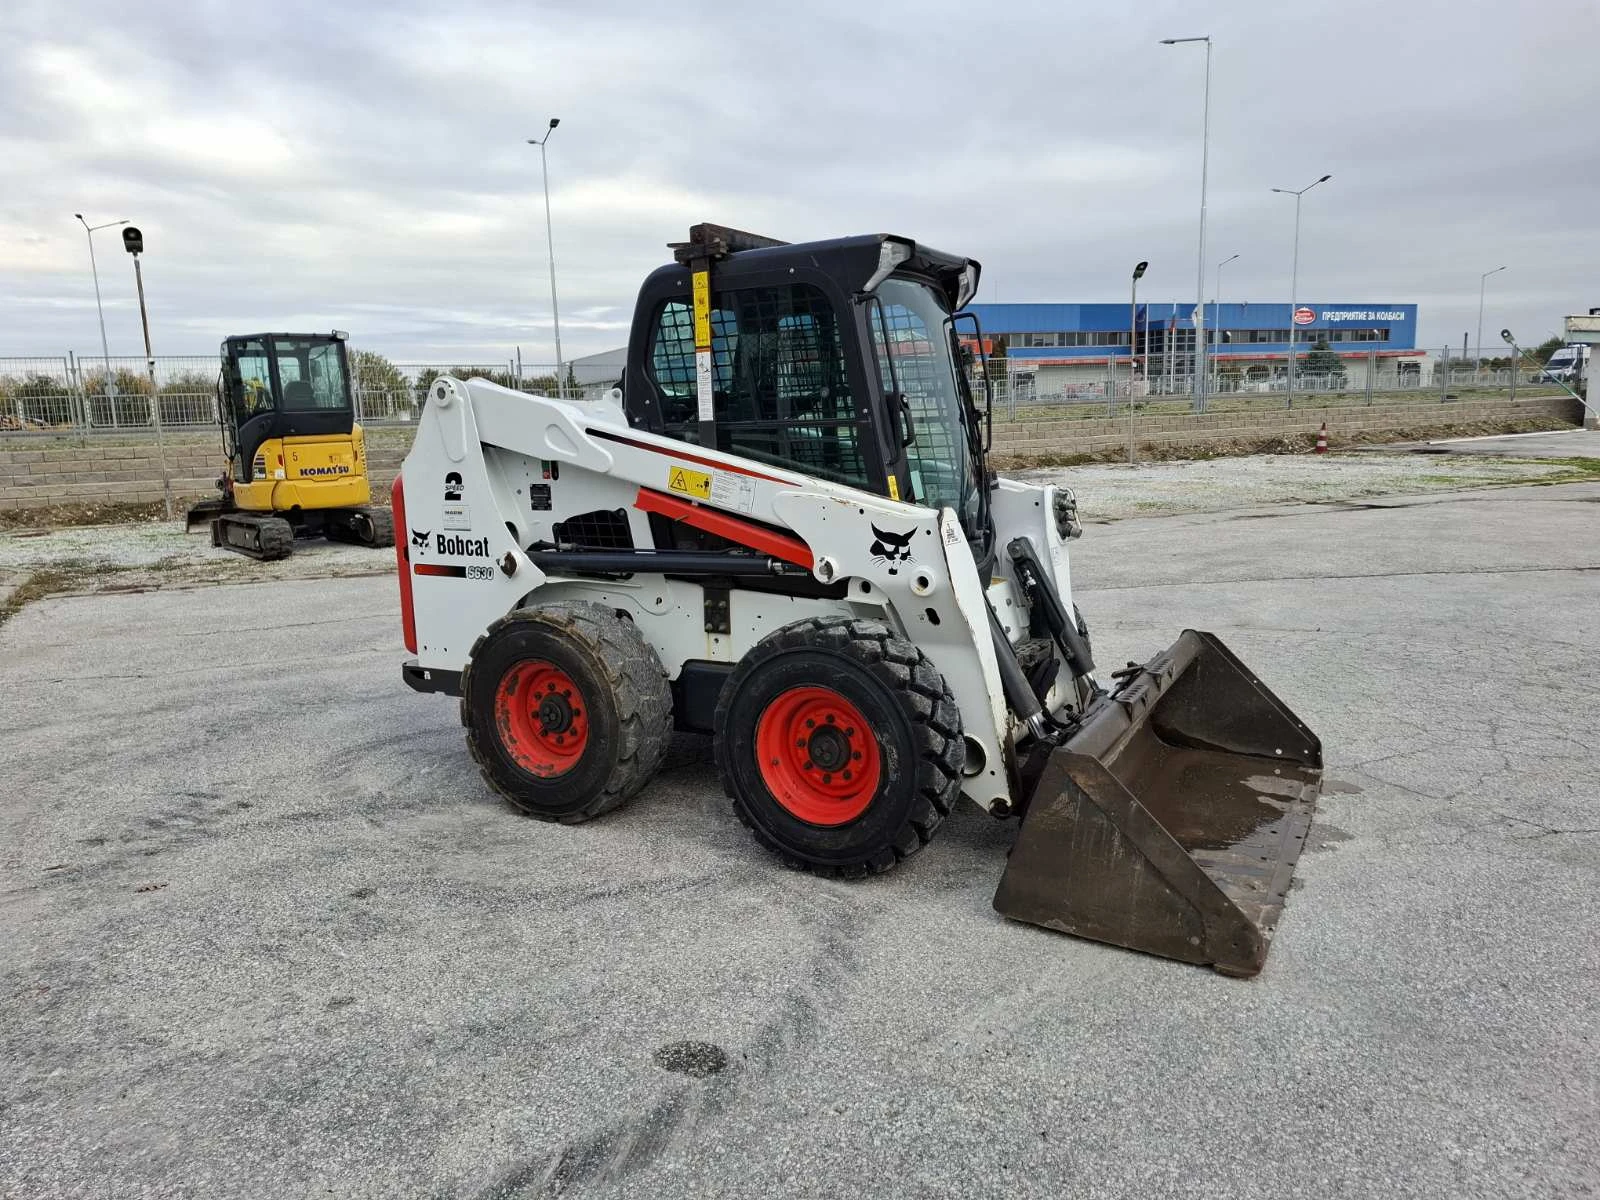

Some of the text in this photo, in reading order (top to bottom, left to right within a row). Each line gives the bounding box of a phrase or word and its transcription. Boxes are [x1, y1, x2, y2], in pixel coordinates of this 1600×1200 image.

[1322, 311, 1367, 322] ПРЕДПРИЯТИЕ
[1368, 311, 1375, 320] ЗА
[1376, 311, 1404, 321] КОЛБАСИ
[300, 465, 349, 476] KOMATSU
[445, 472, 462, 500] 2
[437, 534, 489, 557] Bobcat
[467, 566, 494, 580] S630
